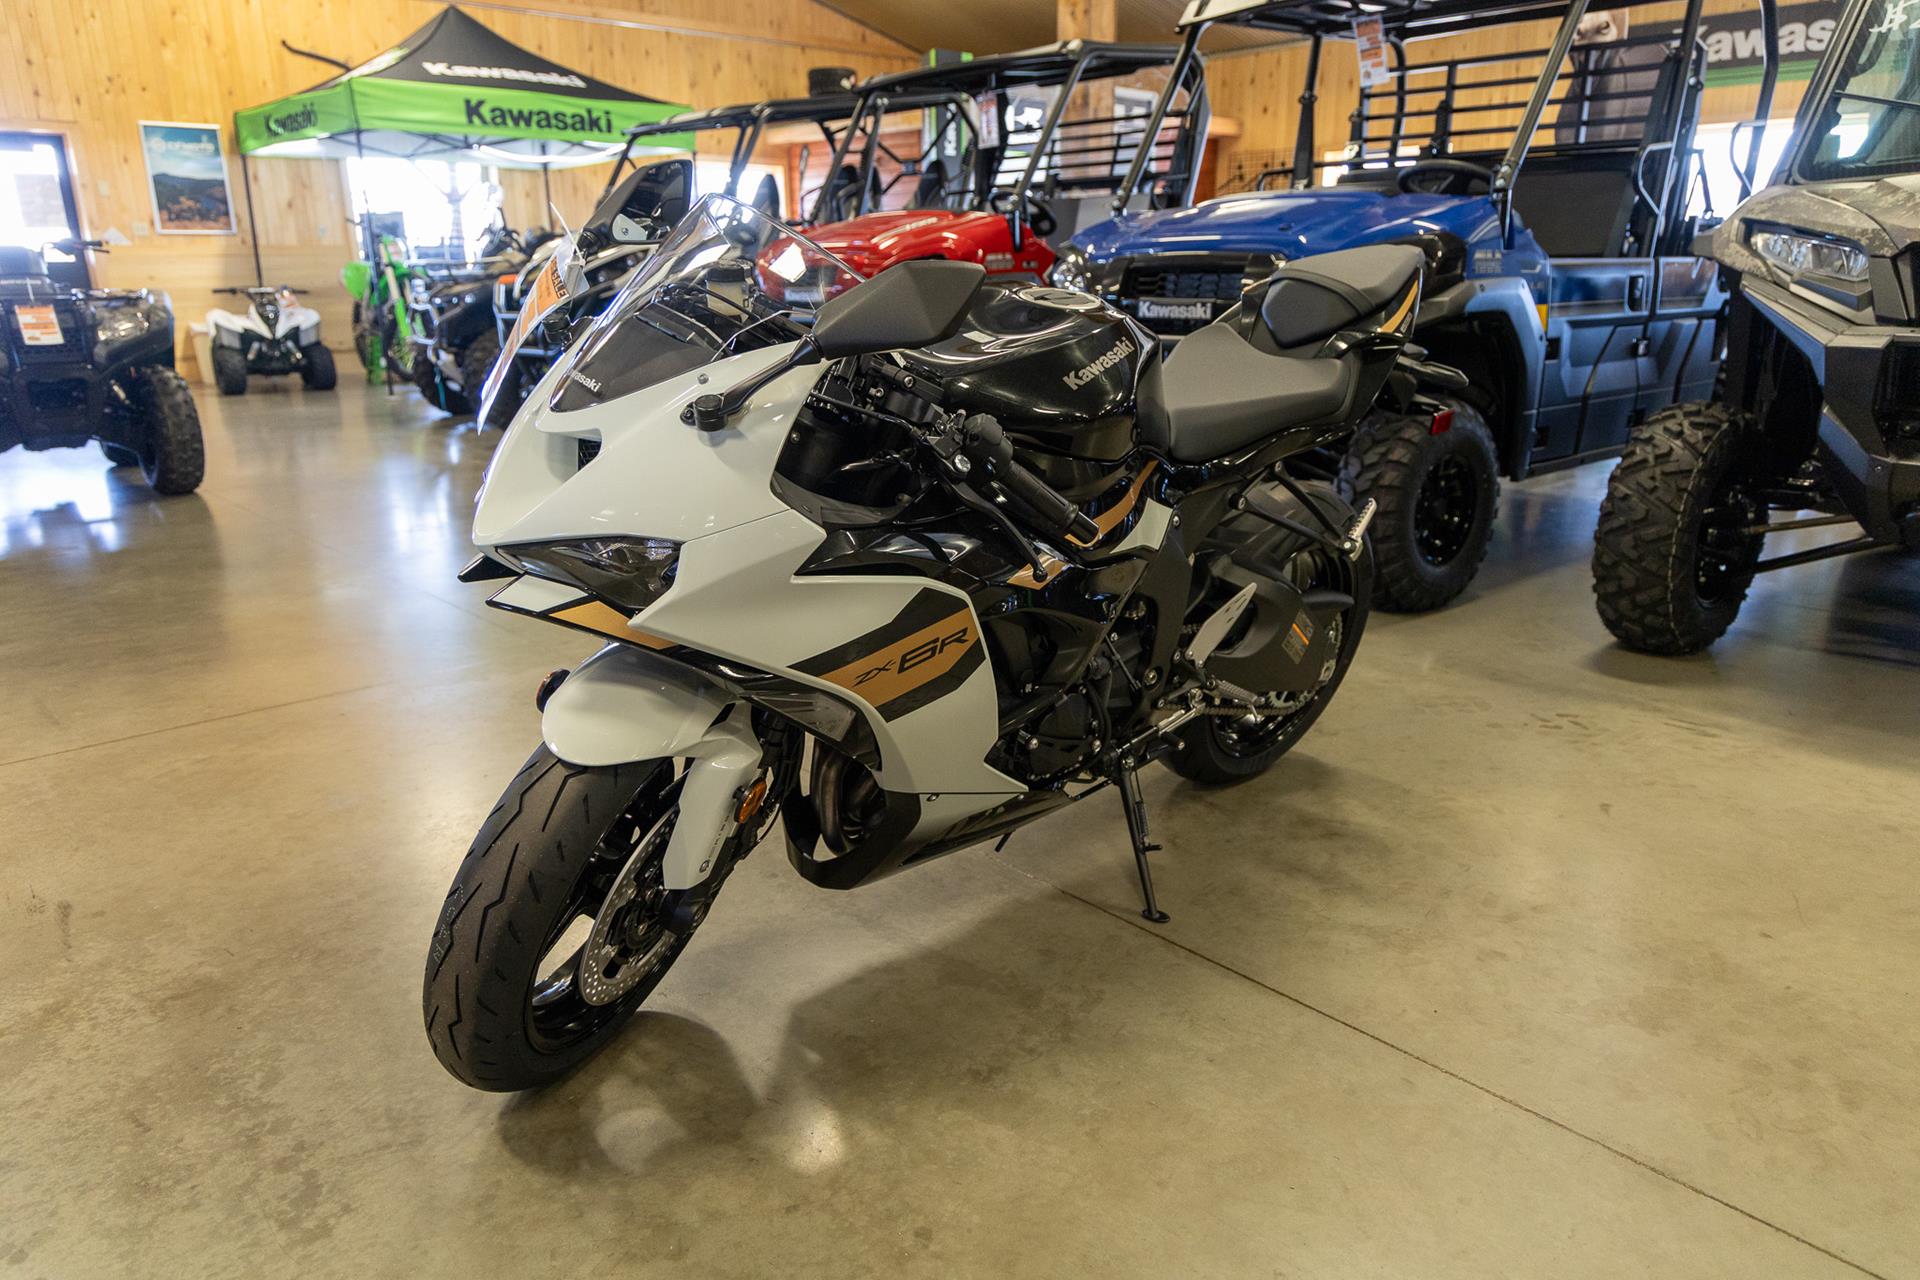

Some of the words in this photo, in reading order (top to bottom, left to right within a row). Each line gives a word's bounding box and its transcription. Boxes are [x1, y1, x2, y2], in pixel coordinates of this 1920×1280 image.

[464, 98, 613, 134] Kawasaki
[1138, 300, 1213, 319] Kawasaki
[1062, 336, 1136, 391] Kawasaki
